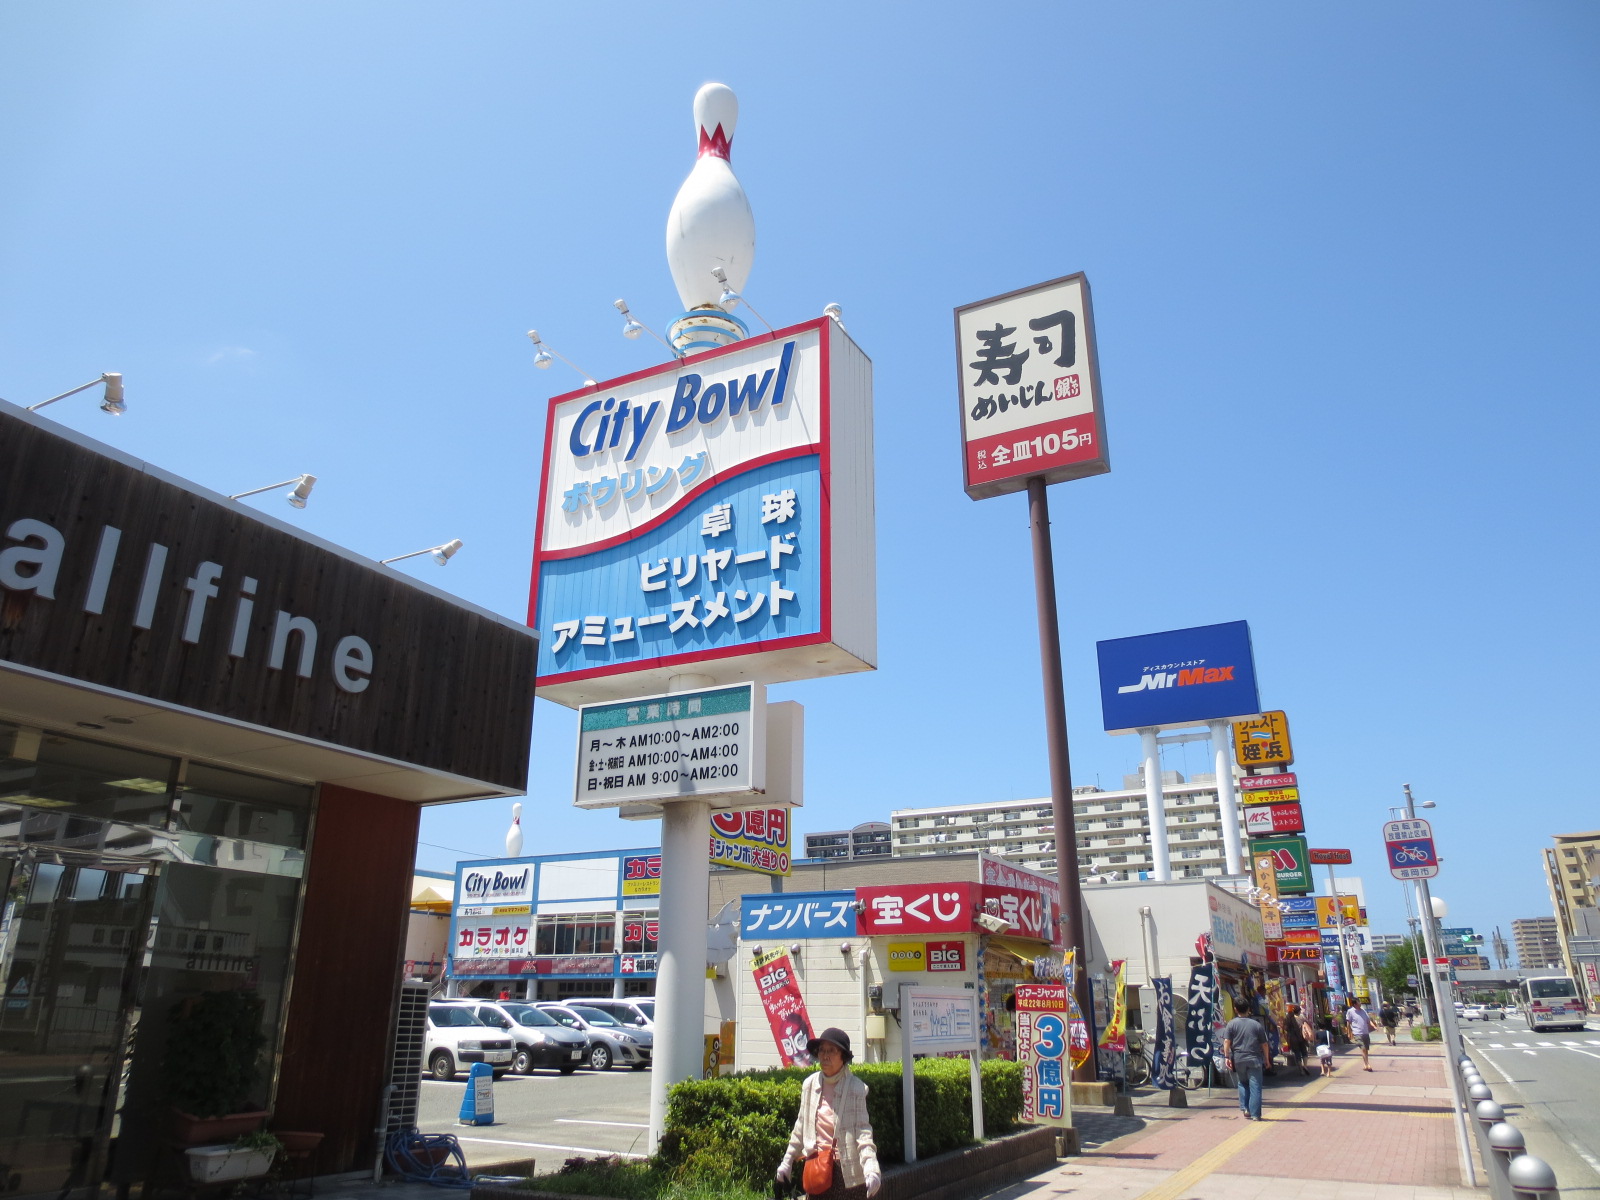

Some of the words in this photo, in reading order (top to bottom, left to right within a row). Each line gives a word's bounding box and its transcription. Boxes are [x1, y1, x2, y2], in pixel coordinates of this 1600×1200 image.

[969, 309, 1076, 387] 寿司
[569, 396, 662, 462] City
[665, 340, 796, 435] Bowl
[970, 380, 1053, 422] めいじん
[561, 451, 707, 514] ボウリング
[640, 532, 797, 593] ビリヤード
[0, 518, 374, 694] allfine
[551, 580, 796, 655] アミューズメント
[465, 872, 492, 898] City
[493, 868, 529, 891] Bowl
[746, 900, 855, 931] ナンバーズ
[872, 891, 961, 925] 宝くじ
[1000, 893, 1042, 932] 宝くじ
[459, 926, 529, 947] カラオケ
[890, 950, 922, 960] toto
[930, 949, 960, 962] BIG
[760, 967, 788, 988] BIG
[1017, 987, 1065, 999] サマージャンボ
[1034, 1013, 1065, 1118] 3億円
